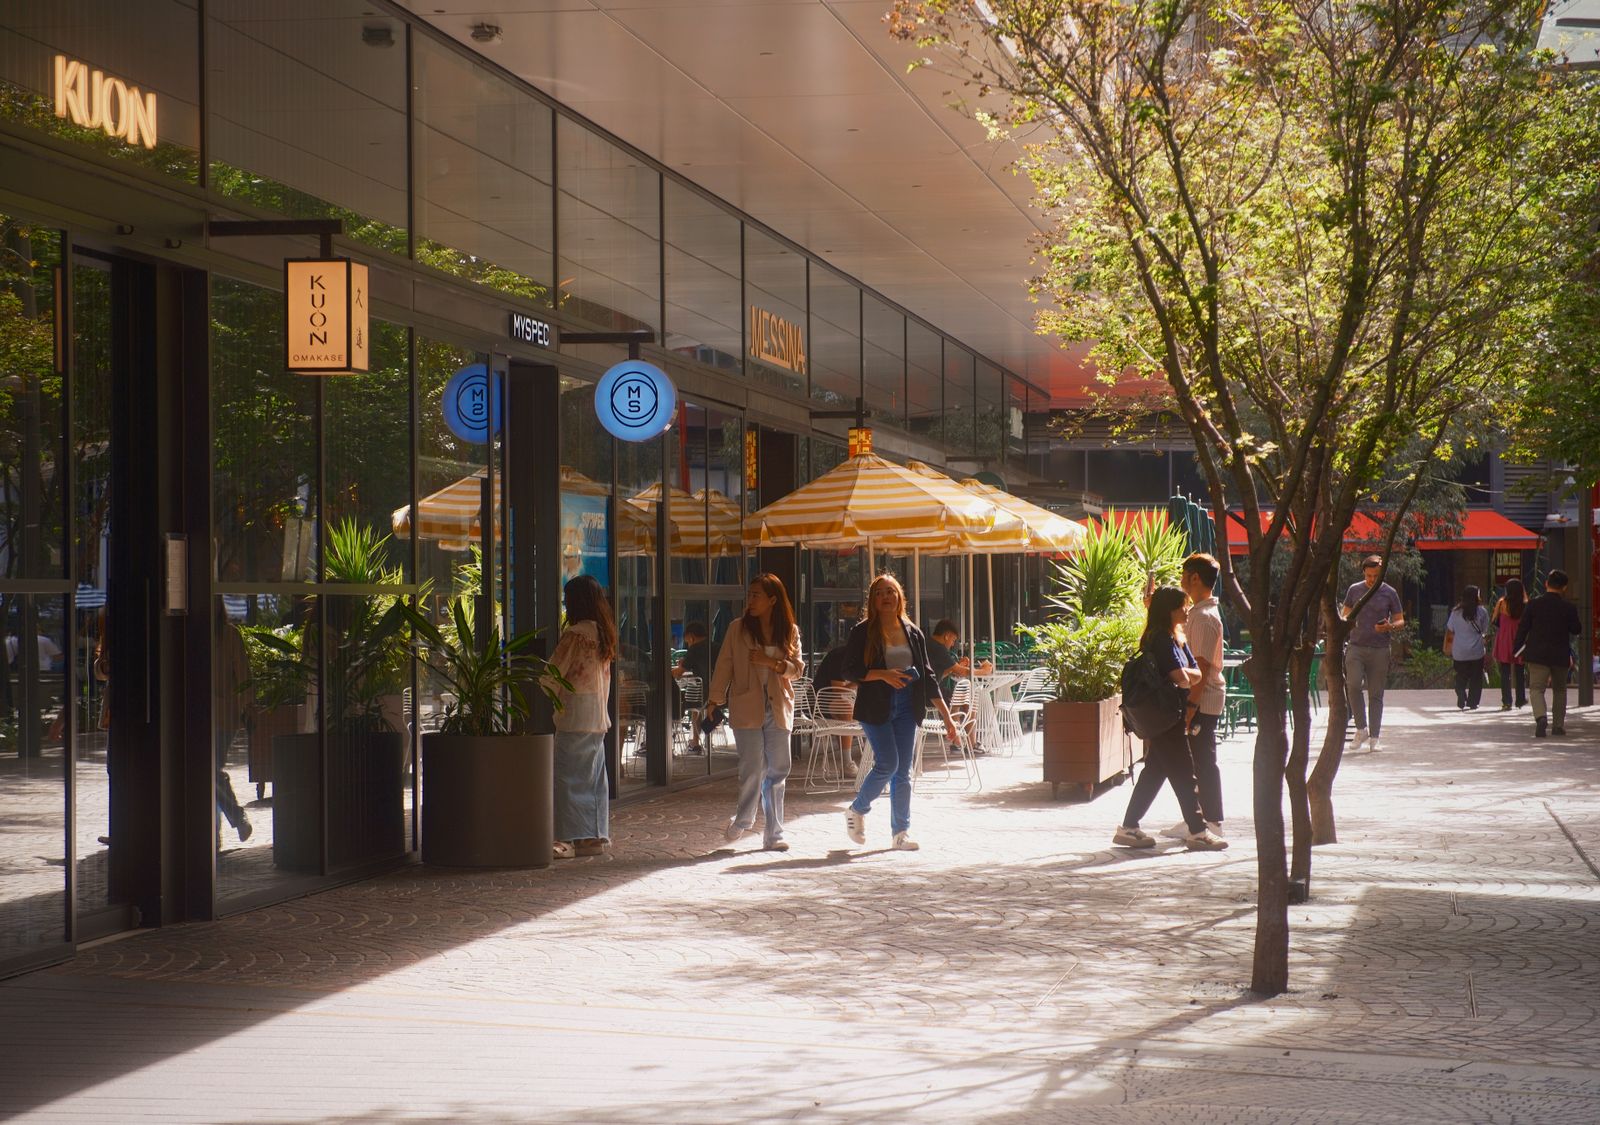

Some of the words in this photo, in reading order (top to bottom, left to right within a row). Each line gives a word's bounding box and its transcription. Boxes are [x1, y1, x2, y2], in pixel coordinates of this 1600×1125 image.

[54, 55, 157, 149] KUON
[310, 275, 327, 346] KUON
[513, 313, 550, 346] MYSPEC
[751, 305, 806, 375] MESSINA
[292, 354, 344, 362] OMAKASE
